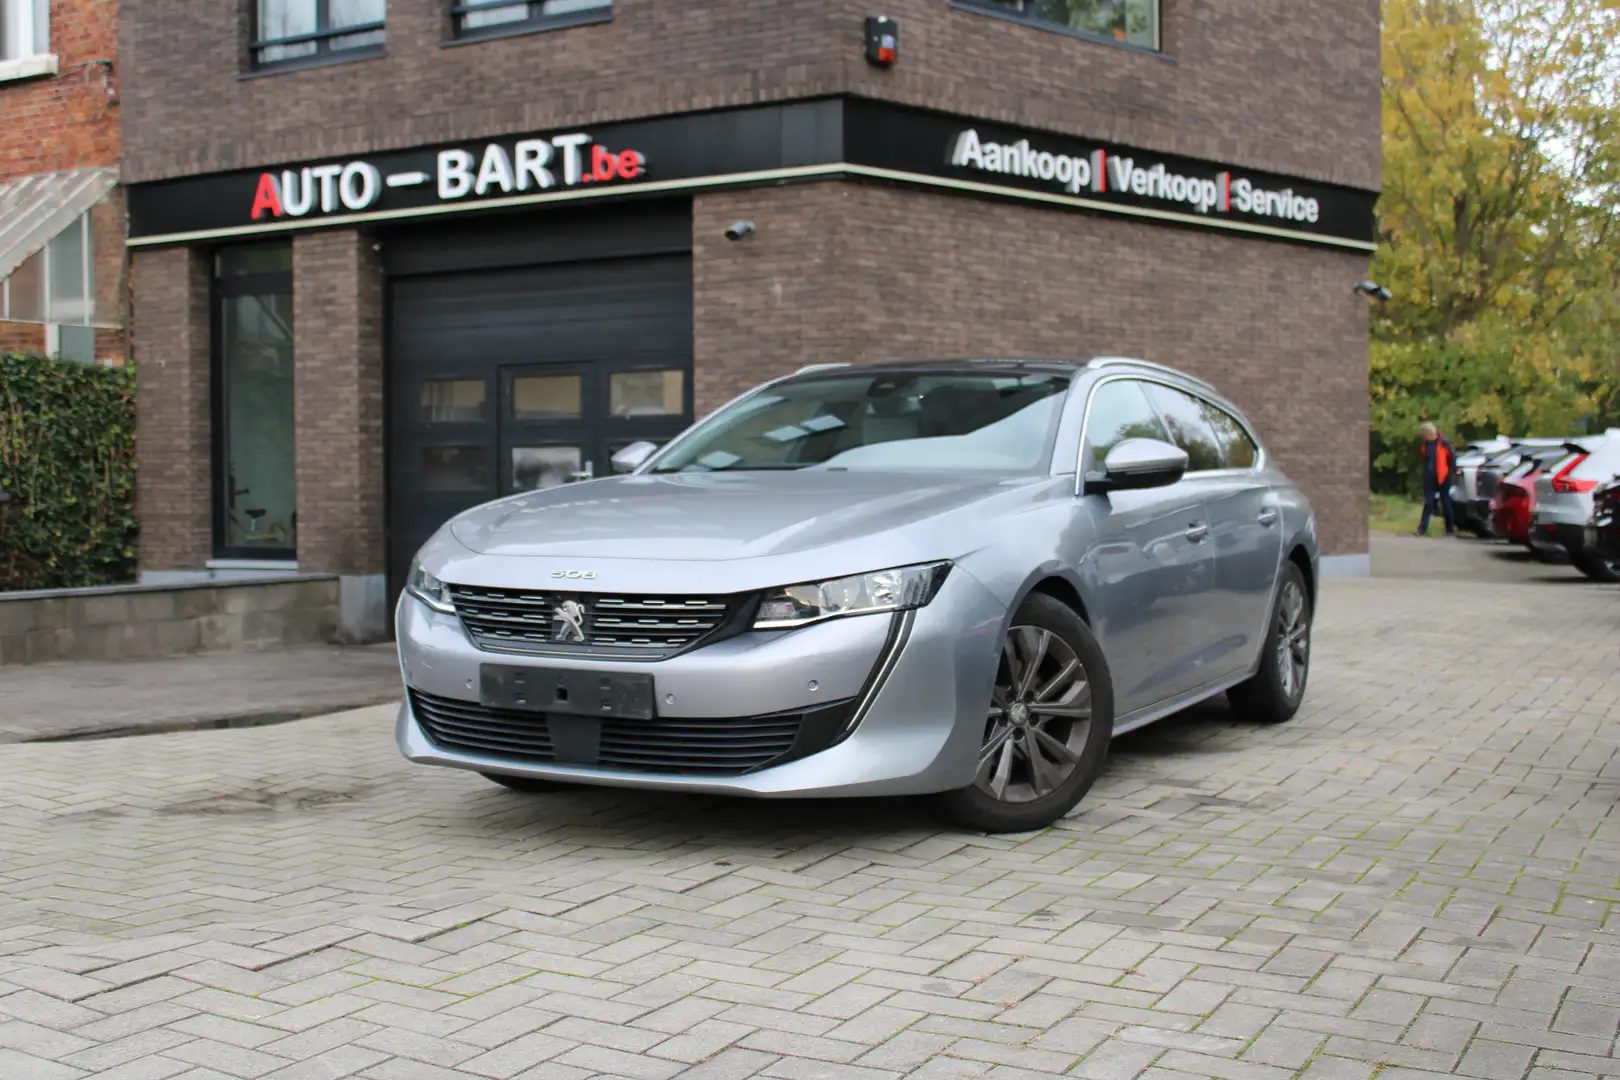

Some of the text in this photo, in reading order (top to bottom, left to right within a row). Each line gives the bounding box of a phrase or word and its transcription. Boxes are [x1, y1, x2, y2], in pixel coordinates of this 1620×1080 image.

[251, 161, 381, 219] AUTO
[953, 128, 1319, 223] Aankoop Verkoop Service
[550, 569, 598, 580] 508
